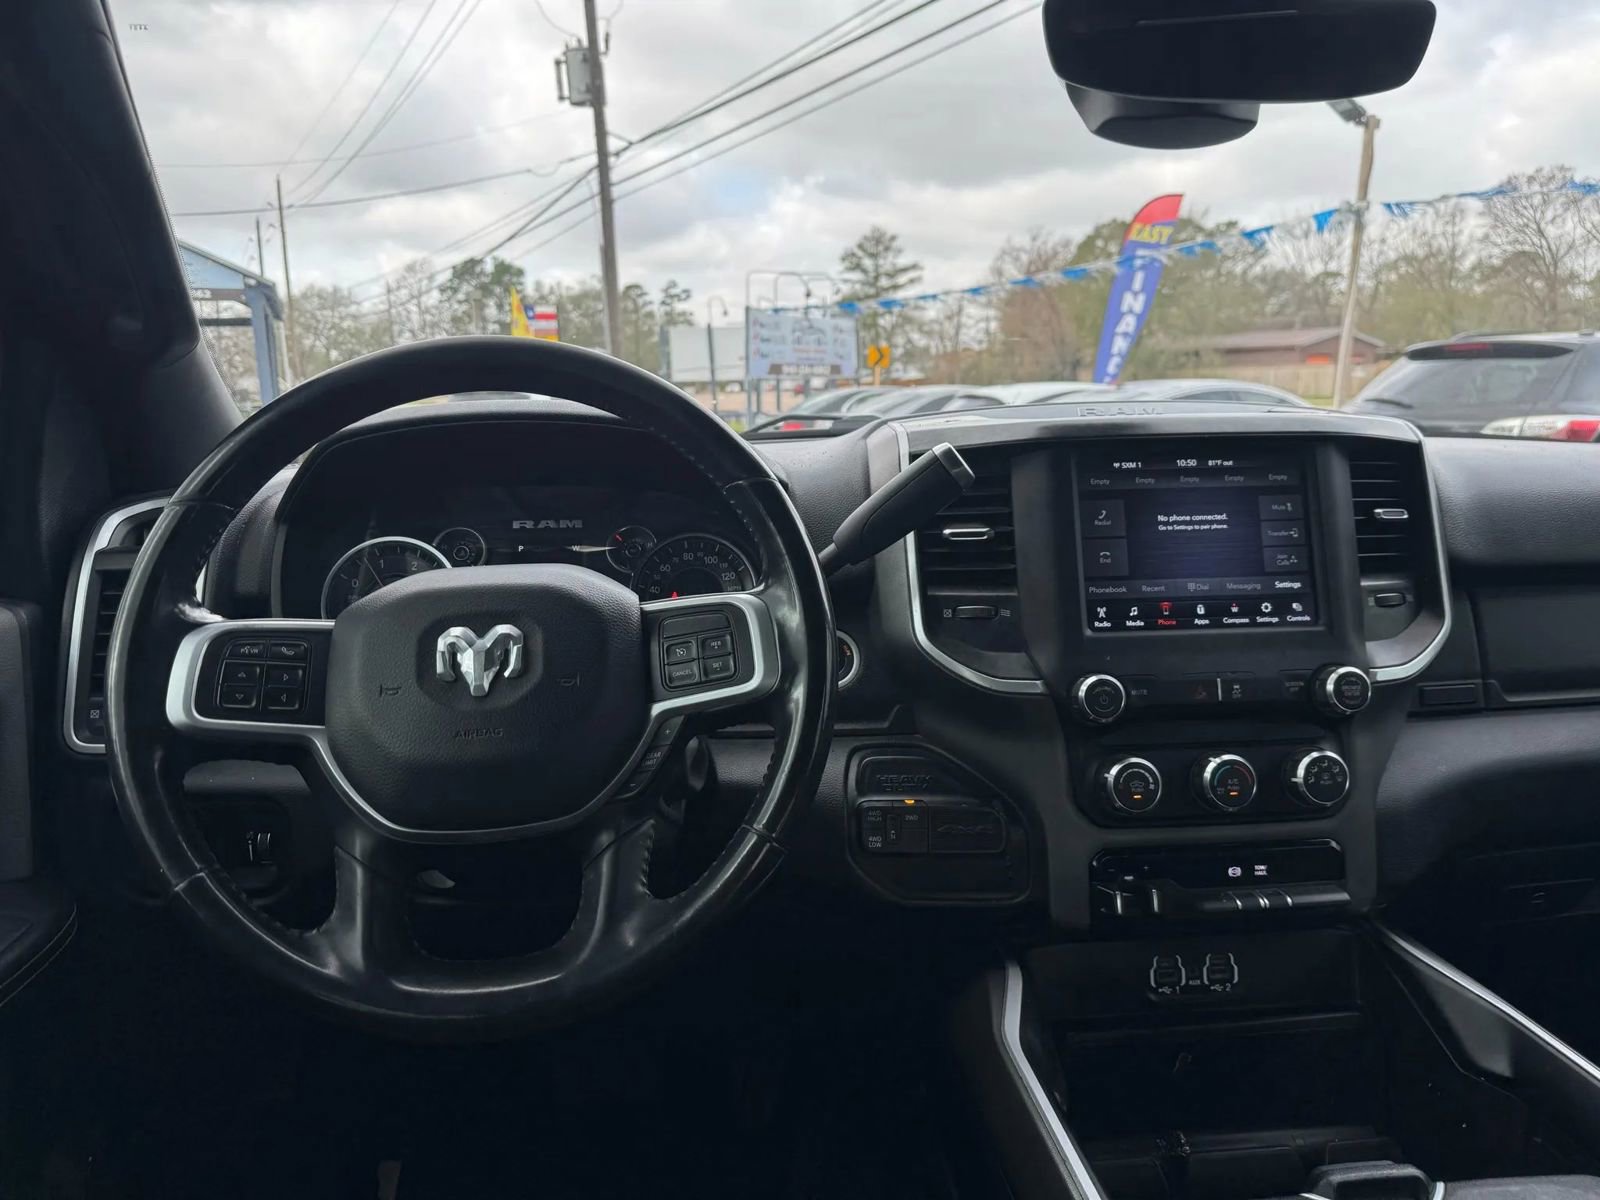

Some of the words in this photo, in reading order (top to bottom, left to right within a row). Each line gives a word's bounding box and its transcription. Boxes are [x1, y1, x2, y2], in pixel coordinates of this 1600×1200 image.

[1128, 223, 1175, 243] EASY
[1103, 248, 1160, 383] FINANC
[1077, 408, 1166, 416] RAM
[1120, 461, 1137, 469] SXM
[1176, 459, 1197, 467] 10:50
[1135, 476, 1155, 485] Empty
[1180, 475, 1200, 483] Empty
[1224, 474, 1244, 482] Empty
[1268, 473, 1288, 481] Empty
[1090, 477, 1110, 486] Empty
[1157, 514, 1168, 522] No
[1169, 515, 1191, 523] phone
[1191, 513, 1228, 521] connected.
[512, 520, 583, 529] RAM
[682, 552, 694, 561] 80
[704, 555, 718, 565] 100
[379, 559, 384, 568] 1
[411, 561, 417, 571] 2
[659, 564, 671, 572] 60
[721, 572, 736, 580] 120
[351, 579, 359, 587] 0
[1196, 583, 1209, 591] Dial
[1226, 582, 1261, 591] Messaging
[1274, 581, 1302, 589] Settings
[649, 586, 661, 594] 40
[1142, 584, 1165, 592] Recent
[1194, 618, 1210, 626] Apps
[672, 670, 692, 678] CANCEL
[455, 728, 504, 739] AIRBAG
